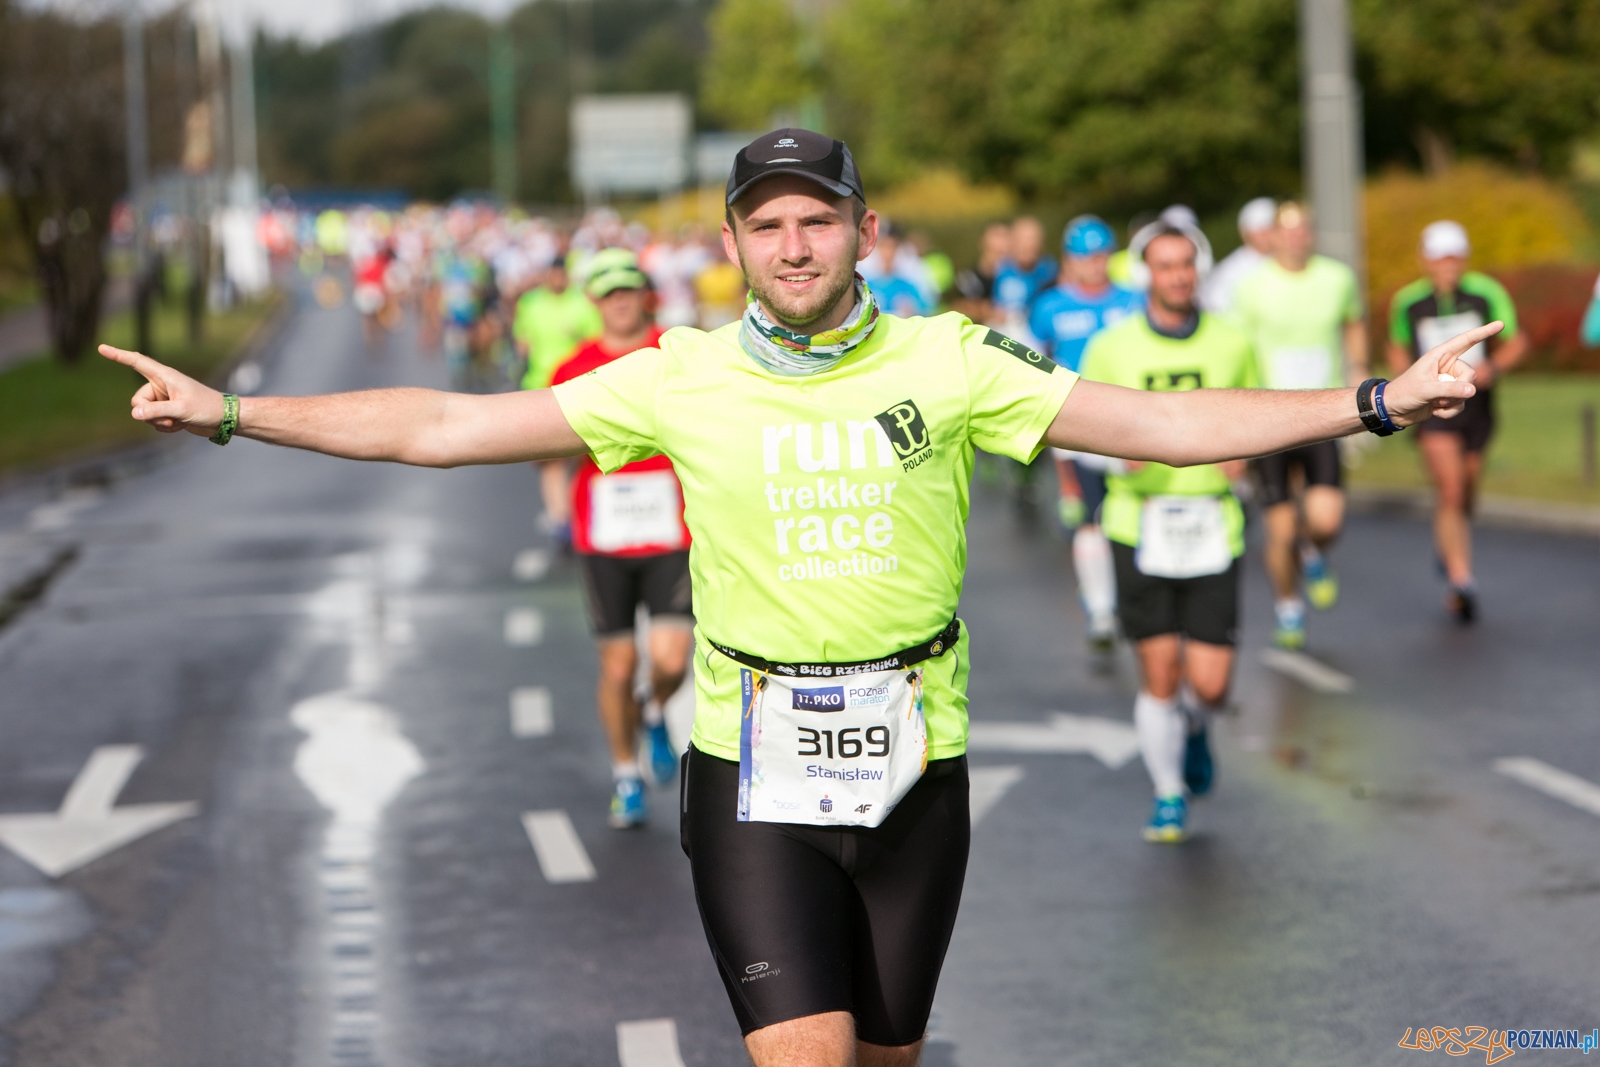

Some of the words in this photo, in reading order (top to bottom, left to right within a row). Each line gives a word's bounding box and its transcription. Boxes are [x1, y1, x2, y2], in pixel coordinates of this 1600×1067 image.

[762, 419, 894, 475] run
[902, 448, 934, 473] POLAND
[764, 477, 897, 513] trekker
[773, 511, 894, 555] race
[778, 553, 898, 582] collection
[849, 694, 891, 706] maraton
[797, 725, 890, 759] 3169
[806, 765, 884, 781] Stanisław
